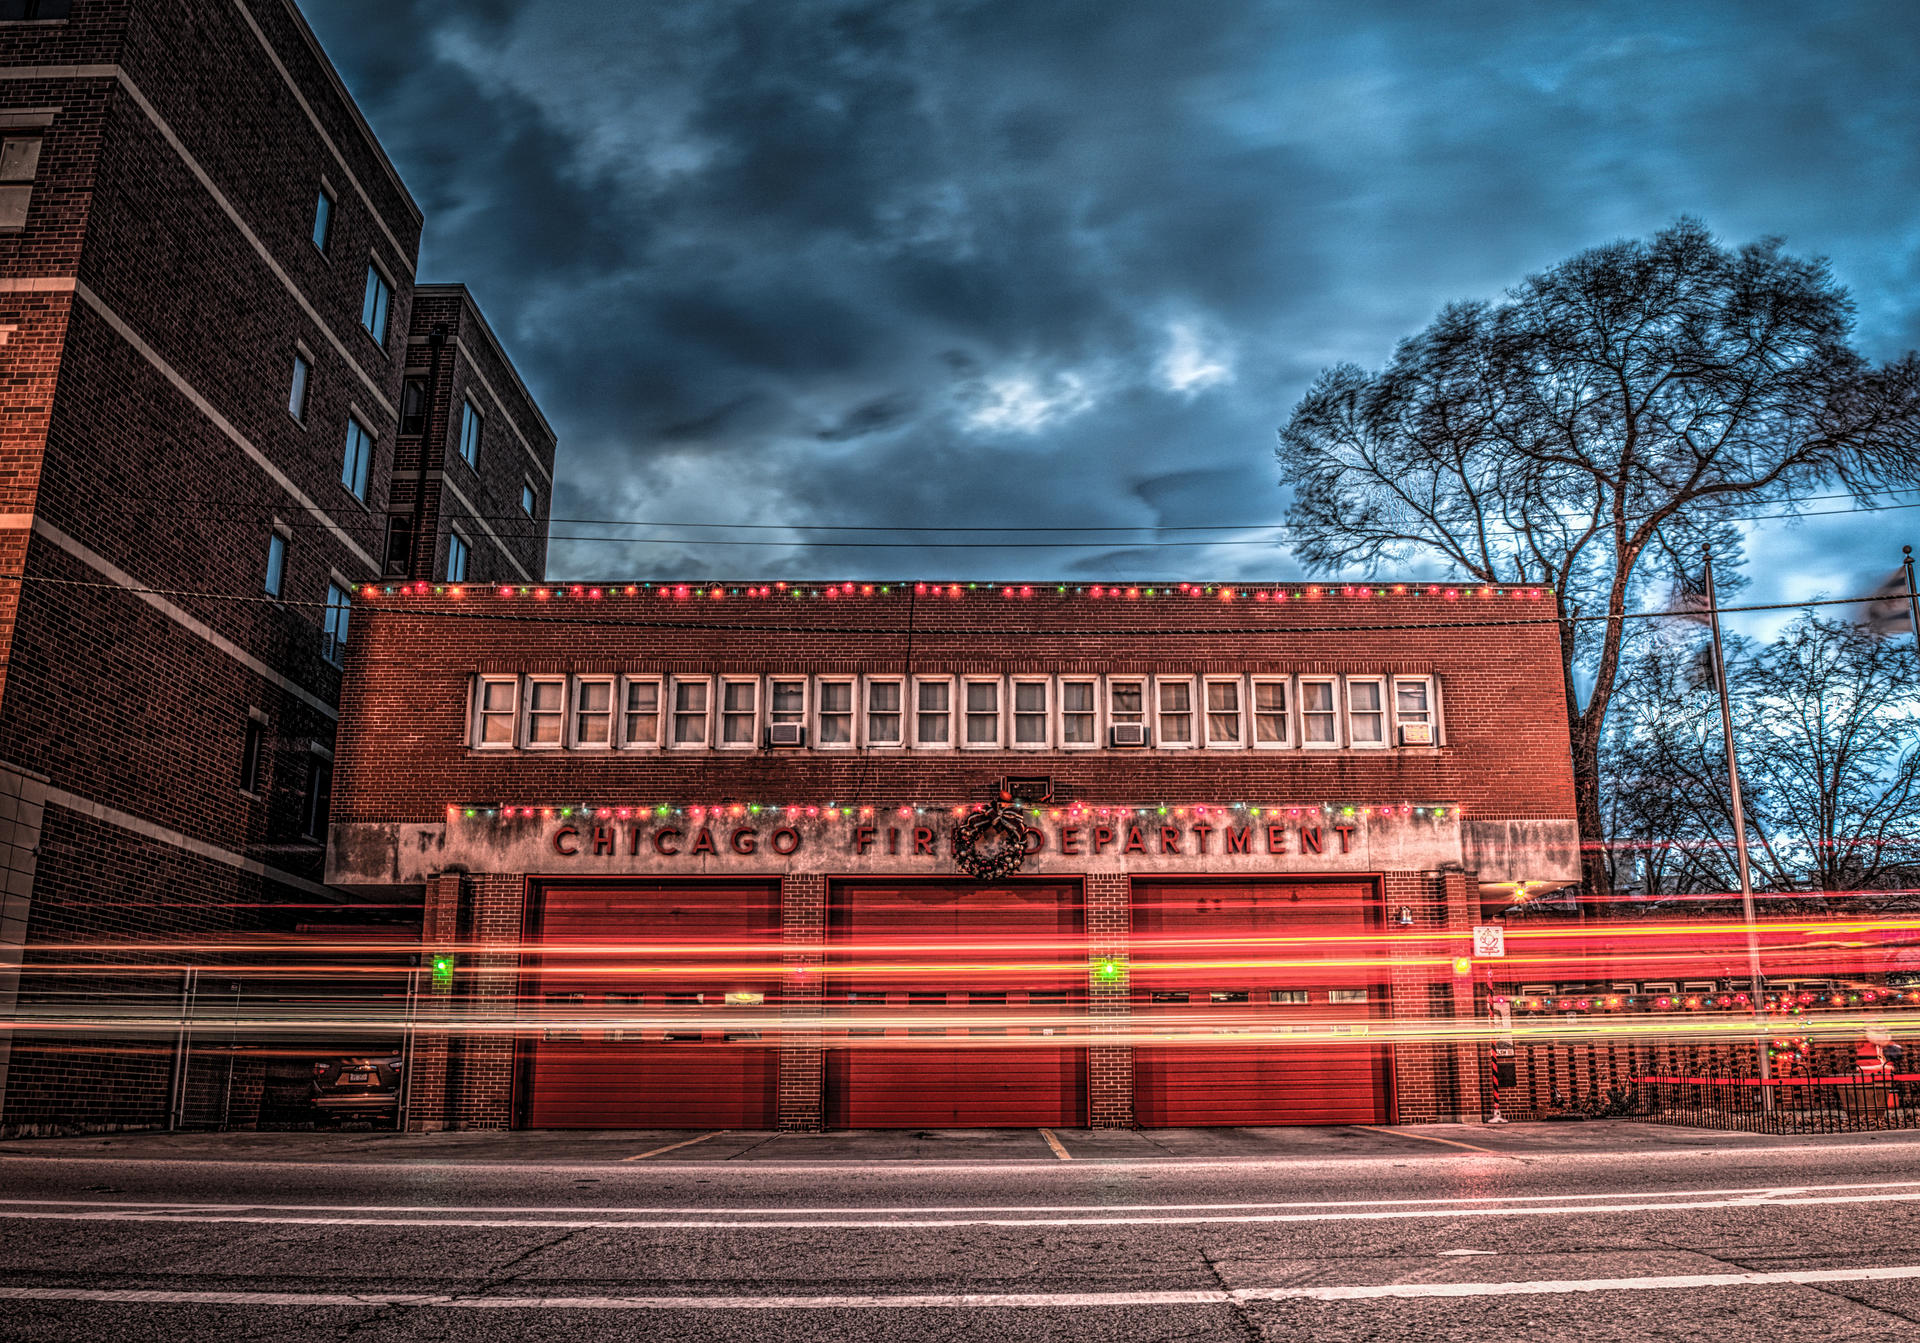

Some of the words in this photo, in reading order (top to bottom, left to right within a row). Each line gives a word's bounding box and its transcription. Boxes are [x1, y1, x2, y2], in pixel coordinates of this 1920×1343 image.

[553, 826, 800, 855] CHICAGO
[856, 826, 958, 855] FIR
[1023, 825, 1356, 855] DEPARTMENT
